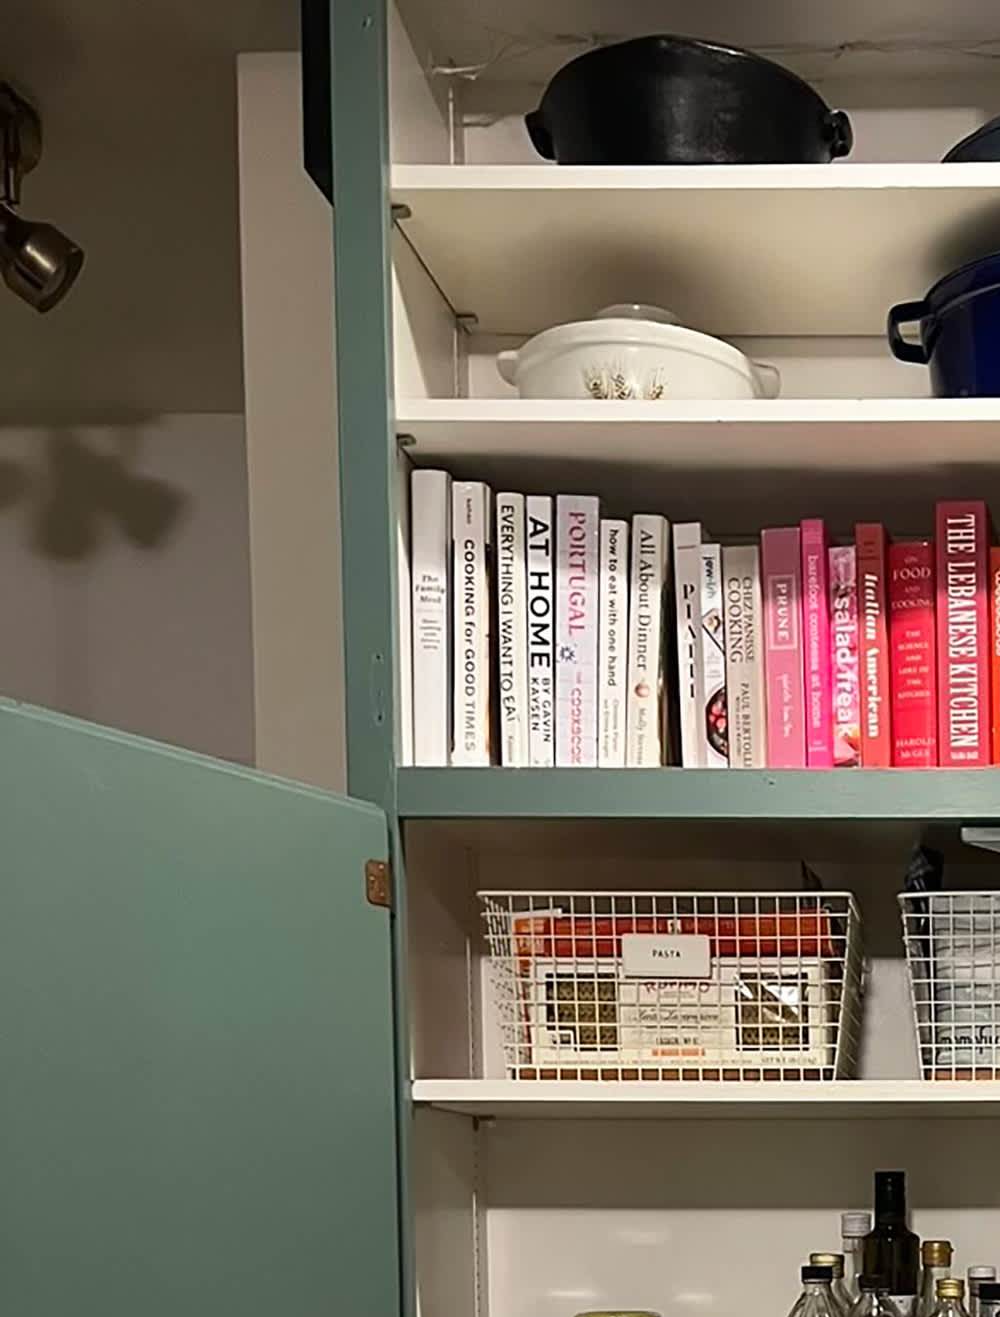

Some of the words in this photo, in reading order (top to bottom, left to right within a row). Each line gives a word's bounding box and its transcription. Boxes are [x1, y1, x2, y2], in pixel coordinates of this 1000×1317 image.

[501, 505, 513, 605] EVERYTHING
[528, 516, 549, 556] AT
[608, 529, 619, 555] how
[640, 530, 655, 554] All
[947, 514, 976, 554] THE
[464, 539, 475, 616] COOKING
[568, 511, 586, 636] PORTUGAL
[607, 575, 618, 594] eat
[608, 559, 619, 572] to
[638, 560, 654, 608] About
[808, 554, 820, 610] barefoot
[893, 567, 931, 580] FOOD
[608, 600, 619, 625] with
[742, 577, 753, 611] CHEZ
[777, 583, 790, 642] PRUNE
[865, 574, 878, 640] Italian
[947, 561, 977, 657] LEBANESE
[464, 621, 476, 643] for
[501, 619, 513, 665] WANT
[529, 571, 550, 668] HOME
[607, 629, 617, 651] one
[636, 614, 652, 670] Dinner
[728, 577, 743, 663] COOKING
[743, 614, 755, 663] PANISSE
[809, 613, 821, 671] contessa
[834, 597, 852, 664] salad
[464, 649, 476, 696] GOOD
[500, 672, 513, 691] TO
[542, 677, 550, 694] BY
[607, 656, 618, 686] hand
[810, 674, 822, 688] at
[867, 647, 882, 738] American
[502, 696, 520, 723] EAT
[531, 677, 540, 731] KAYSEN
[740, 682, 751, 710] PAUL
[811, 691, 823, 727] home
[837, 671, 856, 738] freak
[949, 663, 979, 747] KITCHEN
[464, 699, 476, 752] TIMES
[542, 700, 551, 743] GAVIN
[570, 688, 582, 764] COOKBOOK
[652, 949, 681, 958] PASTA
